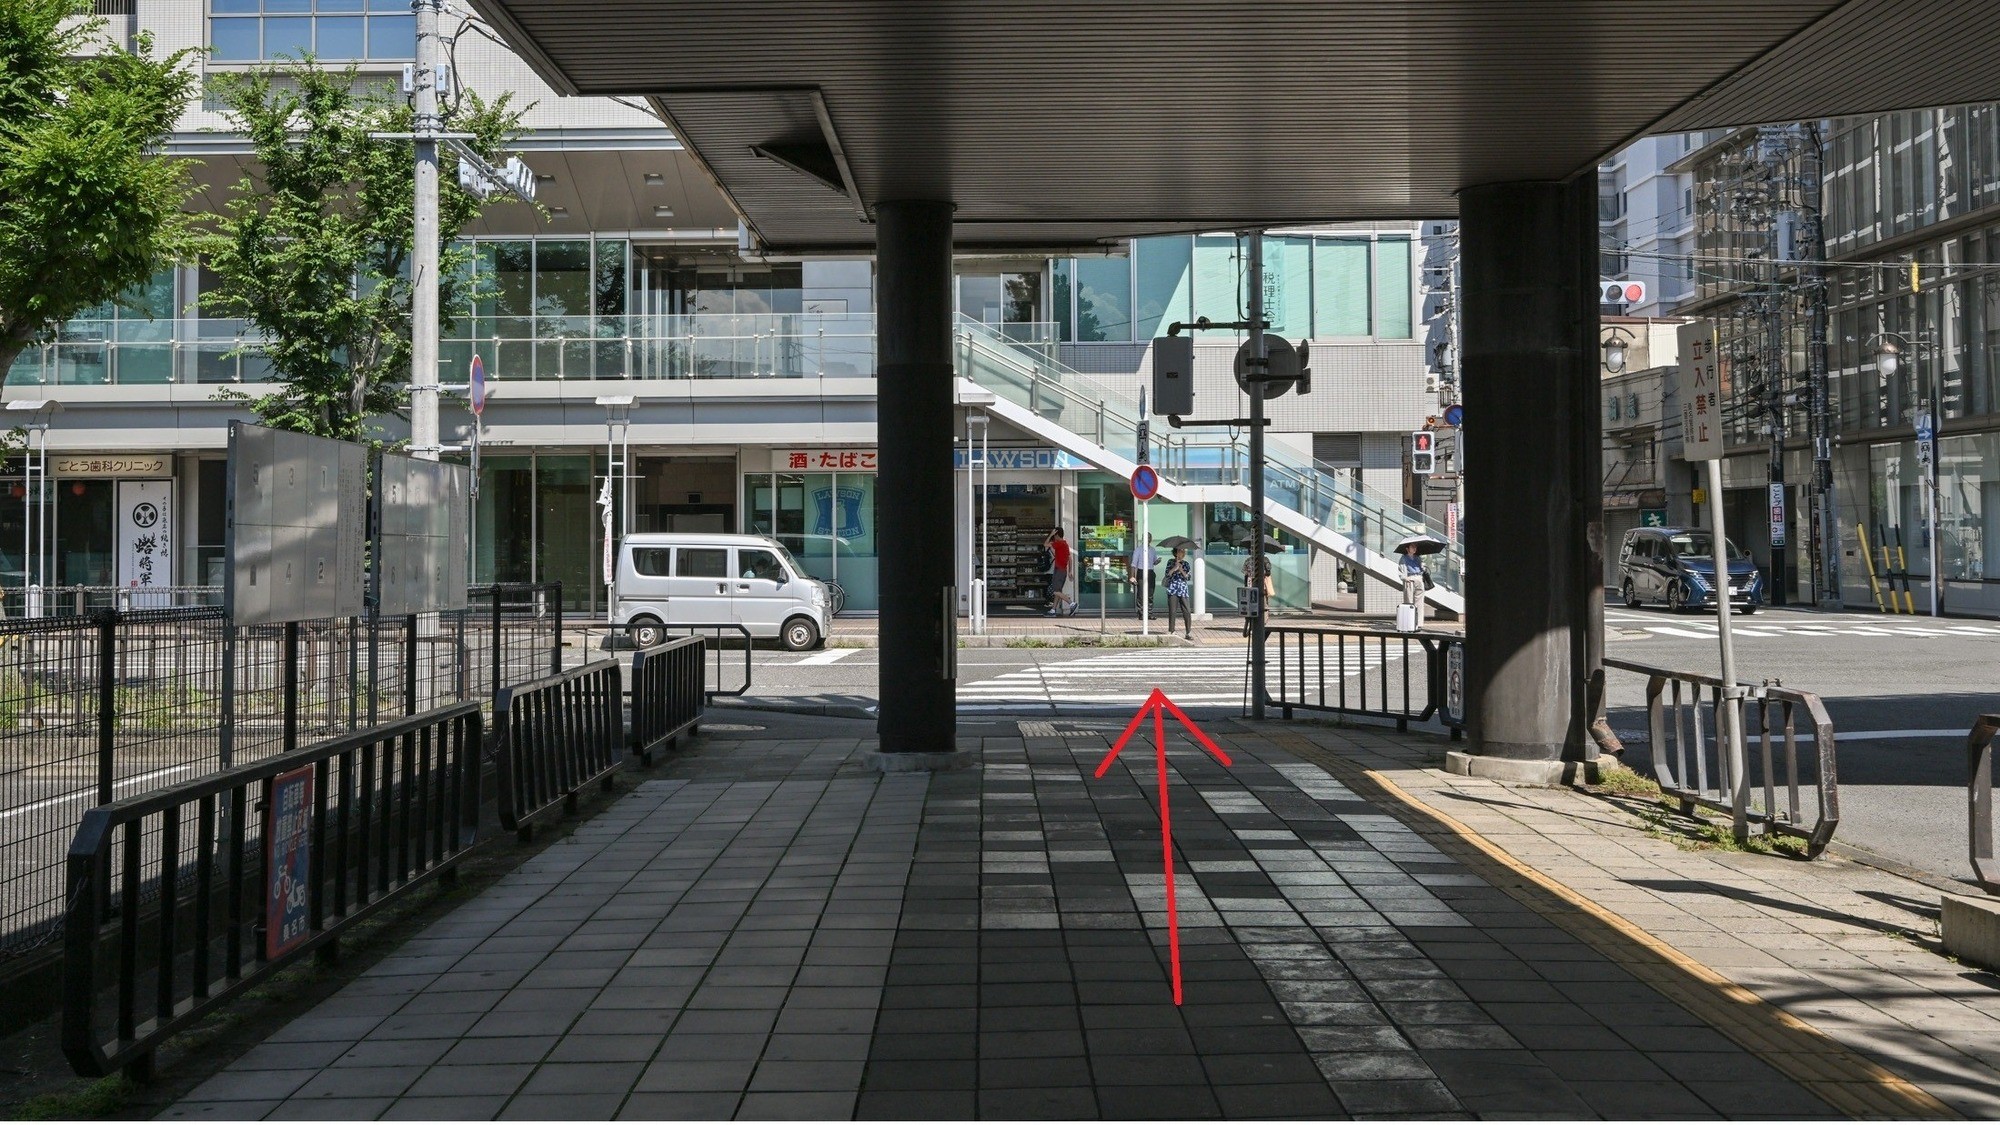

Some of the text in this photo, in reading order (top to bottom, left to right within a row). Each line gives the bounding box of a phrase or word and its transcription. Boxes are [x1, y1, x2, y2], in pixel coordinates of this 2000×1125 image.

[1263, 272, 1276, 323] 税理士会
[1704, 338, 1716, 407] 歩行者
[1692, 339, 1710, 443] 立入禁止
[58, 460, 163, 472] ごとう歯科クリニック
[788, 452, 877, 469] 酒・たばこ
[959, 450, 1071, 468] LAWSON
[288, 467, 294, 486] 3
[1269, 479, 1296, 488] ATM
[817, 489, 861, 500] LAWSON
[318, 561, 324, 579] 2
[283, 914, 306, 943] 桑名市
